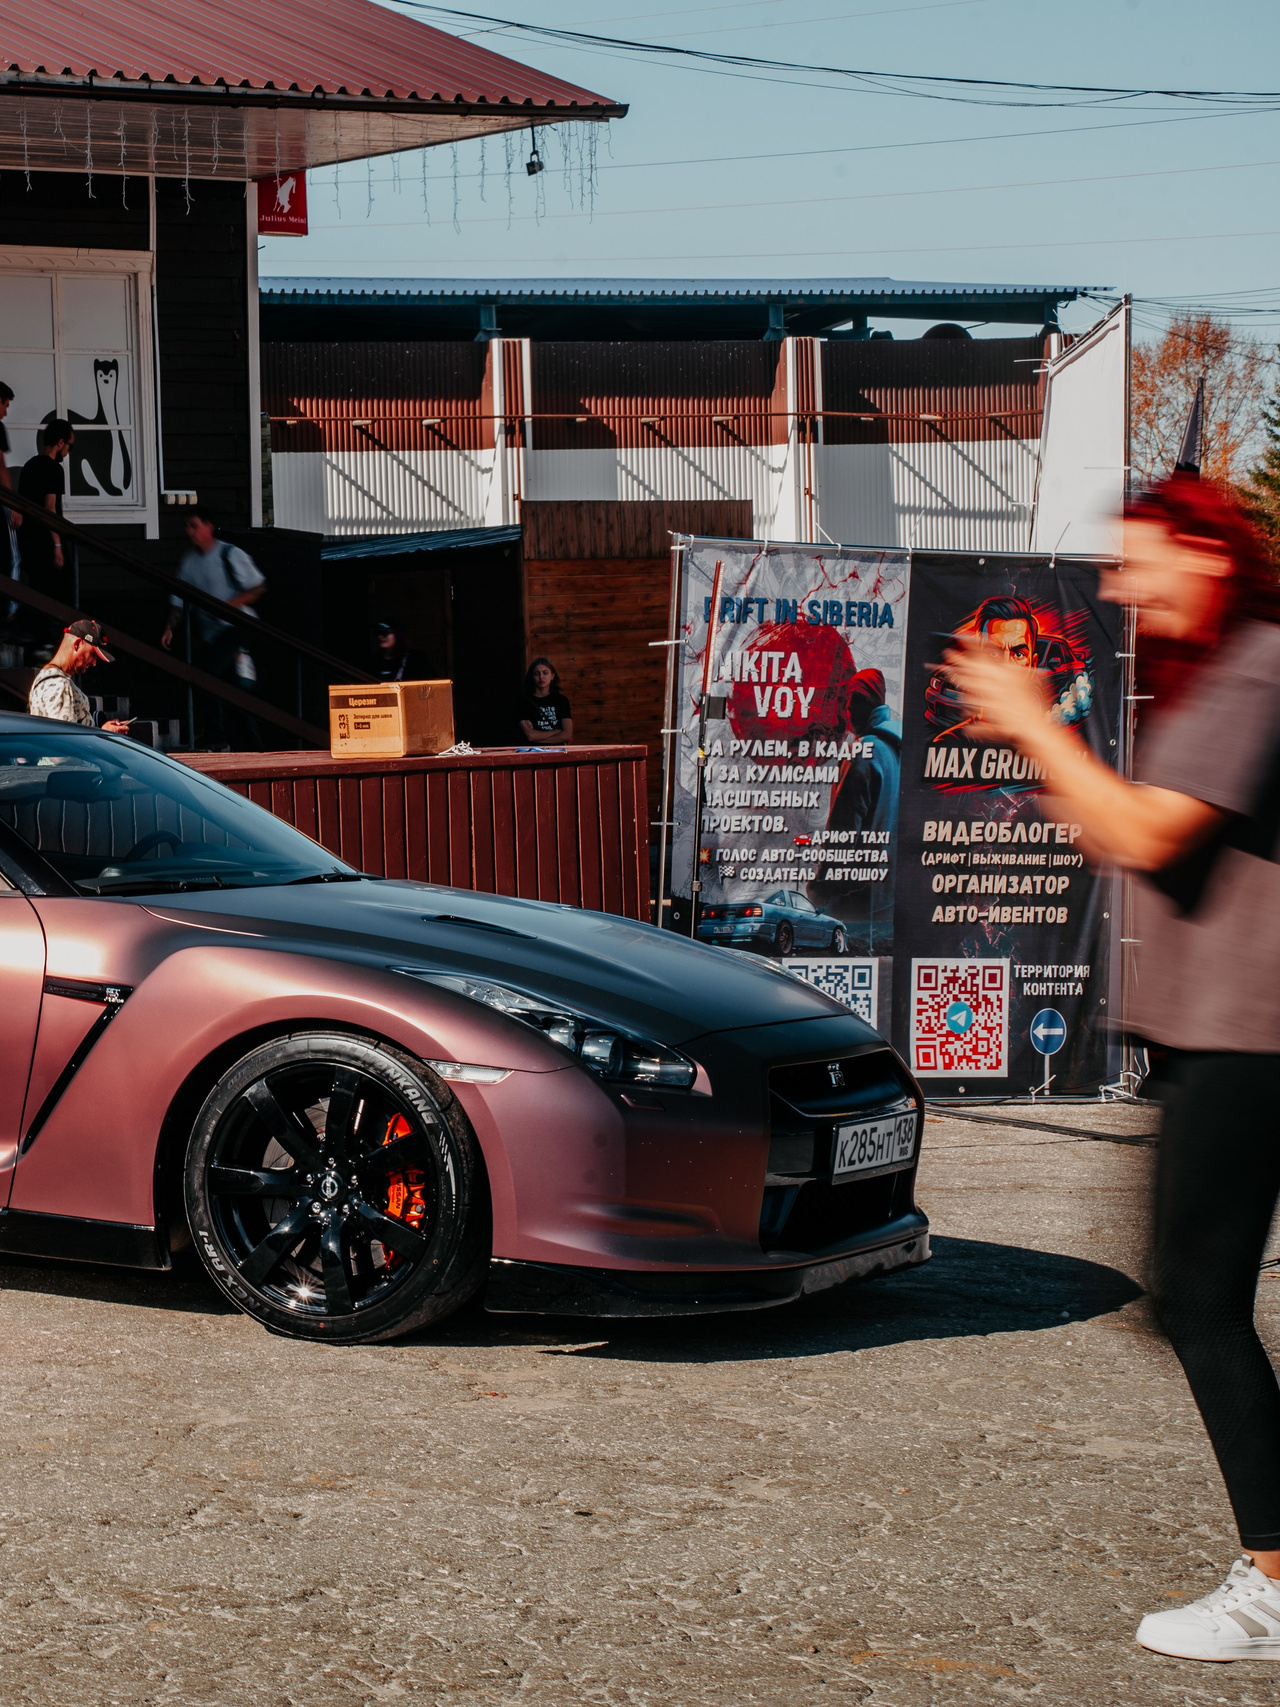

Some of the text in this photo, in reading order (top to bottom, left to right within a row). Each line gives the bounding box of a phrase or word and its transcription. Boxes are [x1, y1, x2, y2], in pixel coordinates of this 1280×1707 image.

[259, 214, 307, 224] Julius Meinl
[775, 598, 798, 625] IN
[807, 599, 895, 628] SIBERIA
[348, 697, 377, 707] Церезит
[753, 686, 815, 719] VOY
[730, 739, 792, 759] РУЛЕМ,
[798, 741, 811, 758] В
[815, 740, 874, 761] КАДРЕ
[924, 747, 978, 779] MAX
[719, 764, 740, 783] ЗА
[746, 765, 840, 784] КУЛИСАМИ
[811, 830, 890, 846] ДРИФТ TAXI
[923, 820, 1083, 846] ВИДЕОБЛОГЕР
[715, 848, 889, 864] ГОЛОС АВТО-СООБЩЕСТВА
[739, 867, 889, 883] СОЗДАТЕЛЬ АВТОШОУ
[932, 874, 1070, 895] ОРГАНИЗАТОР
[932, 905, 1068, 924] АВТО-ИВЕНТОВ
[1014, 964, 1091, 979] ТЕРРИТОРИЯ
[1023, 982, 1084, 996] КОНТЕНТА
[896, 1116, 914, 1146] 138
[899, 1146, 909, 1157] RUS
